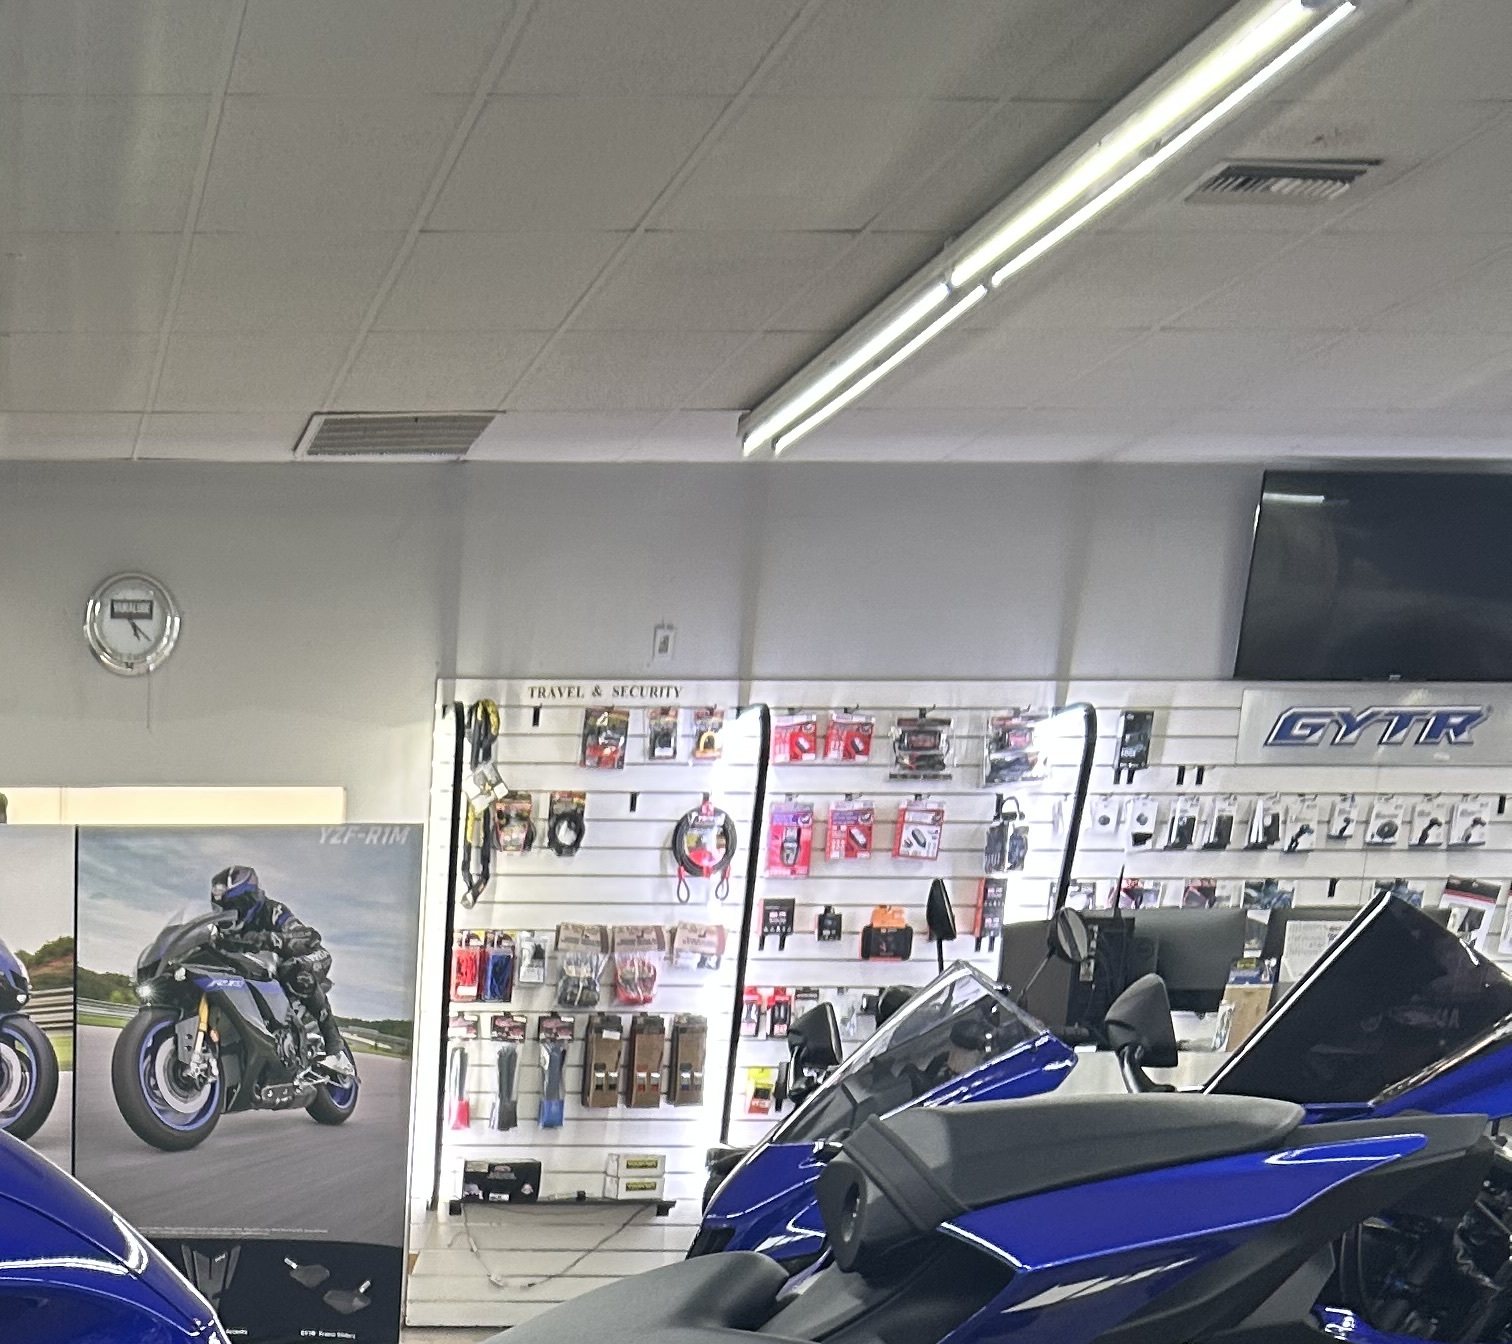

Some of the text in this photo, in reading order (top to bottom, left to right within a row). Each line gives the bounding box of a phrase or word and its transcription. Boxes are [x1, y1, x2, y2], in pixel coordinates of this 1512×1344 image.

[528, 684, 682, 699] TRAVEL & SECURITY
[319, 826, 411, 845] YZF-R1M
